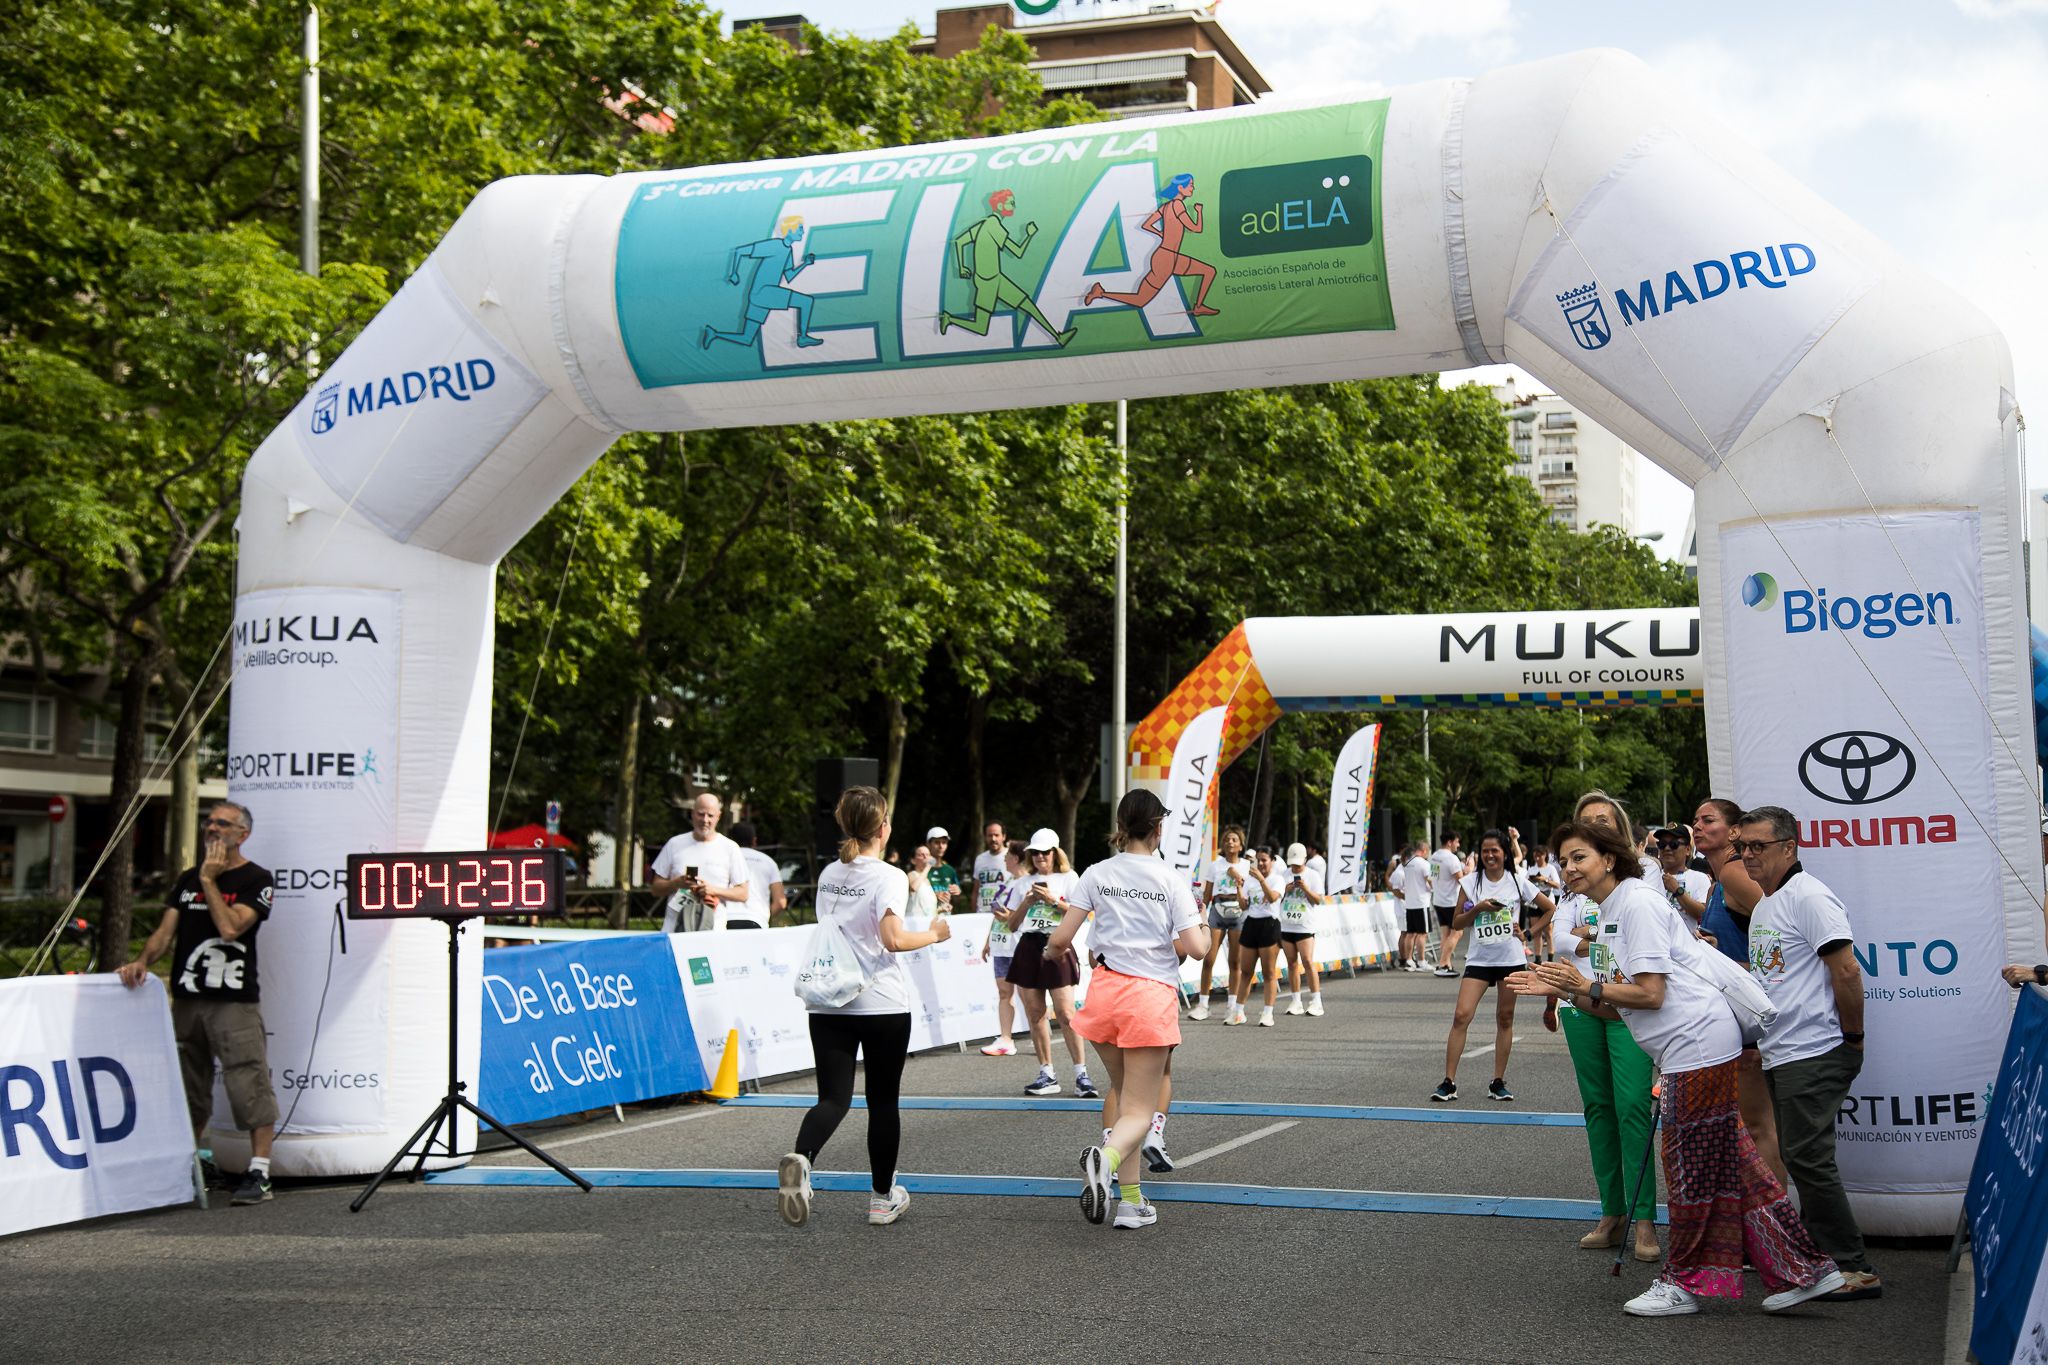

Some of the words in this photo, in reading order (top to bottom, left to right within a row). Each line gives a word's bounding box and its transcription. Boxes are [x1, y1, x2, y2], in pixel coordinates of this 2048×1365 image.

[679, 176, 784, 198] Carrera
[790, 153, 978, 191] MADRID
[987, 139, 1093, 170] CON
[1098, 131, 1159, 158] LA
[1240, 196, 1350, 236] adELA
[760, 160, 1203, 372] ELA
[1223, 263, 1280, 280] Asociación
[1282, 259, 1330, 274] Española
[1332, 259, 1346, 269] de
[1225, 281, 1277, 295] Esclerosis
[1279, 277, 1315, 291] Lateral
[1317, 272, 1379, 287] Amiotrófica
[1614, 243, 1817, 327] MADRID
[347, 358, 496, 417] MADRID
[1783, 587, 1954, 639] Biogen
[234, 616, 379, 648] MUKUA
[1523, 671, 1563, 685] FULL
[1568, 670, 1593, 684] OF
[1598, 667, 1685, 683] COLOURS
[312, 781, 356, 791] EVENTOS
[1340, 765, 1363, 874] MUKUA
[361, 858, 546, 910] 00:42:36
[1097, 885, 1167, 903] VelillaGroup.
[1286, 912, 1302, 920] 949
[1477, 923, 1511, 939] 1005
[483, 974, 544, 1025] De
[537, 967, 576, 1016] la
[569, 962, 638, 1012] Base
[1899, 986, 1962, 999] Solutions
[282, 1068, 379, 1090] Services
[523, 1042, 554, 1094] al
[1914, 1131, 1922, 1142] Y
[1925, 1128, 1977, 1142] EVENTOS
